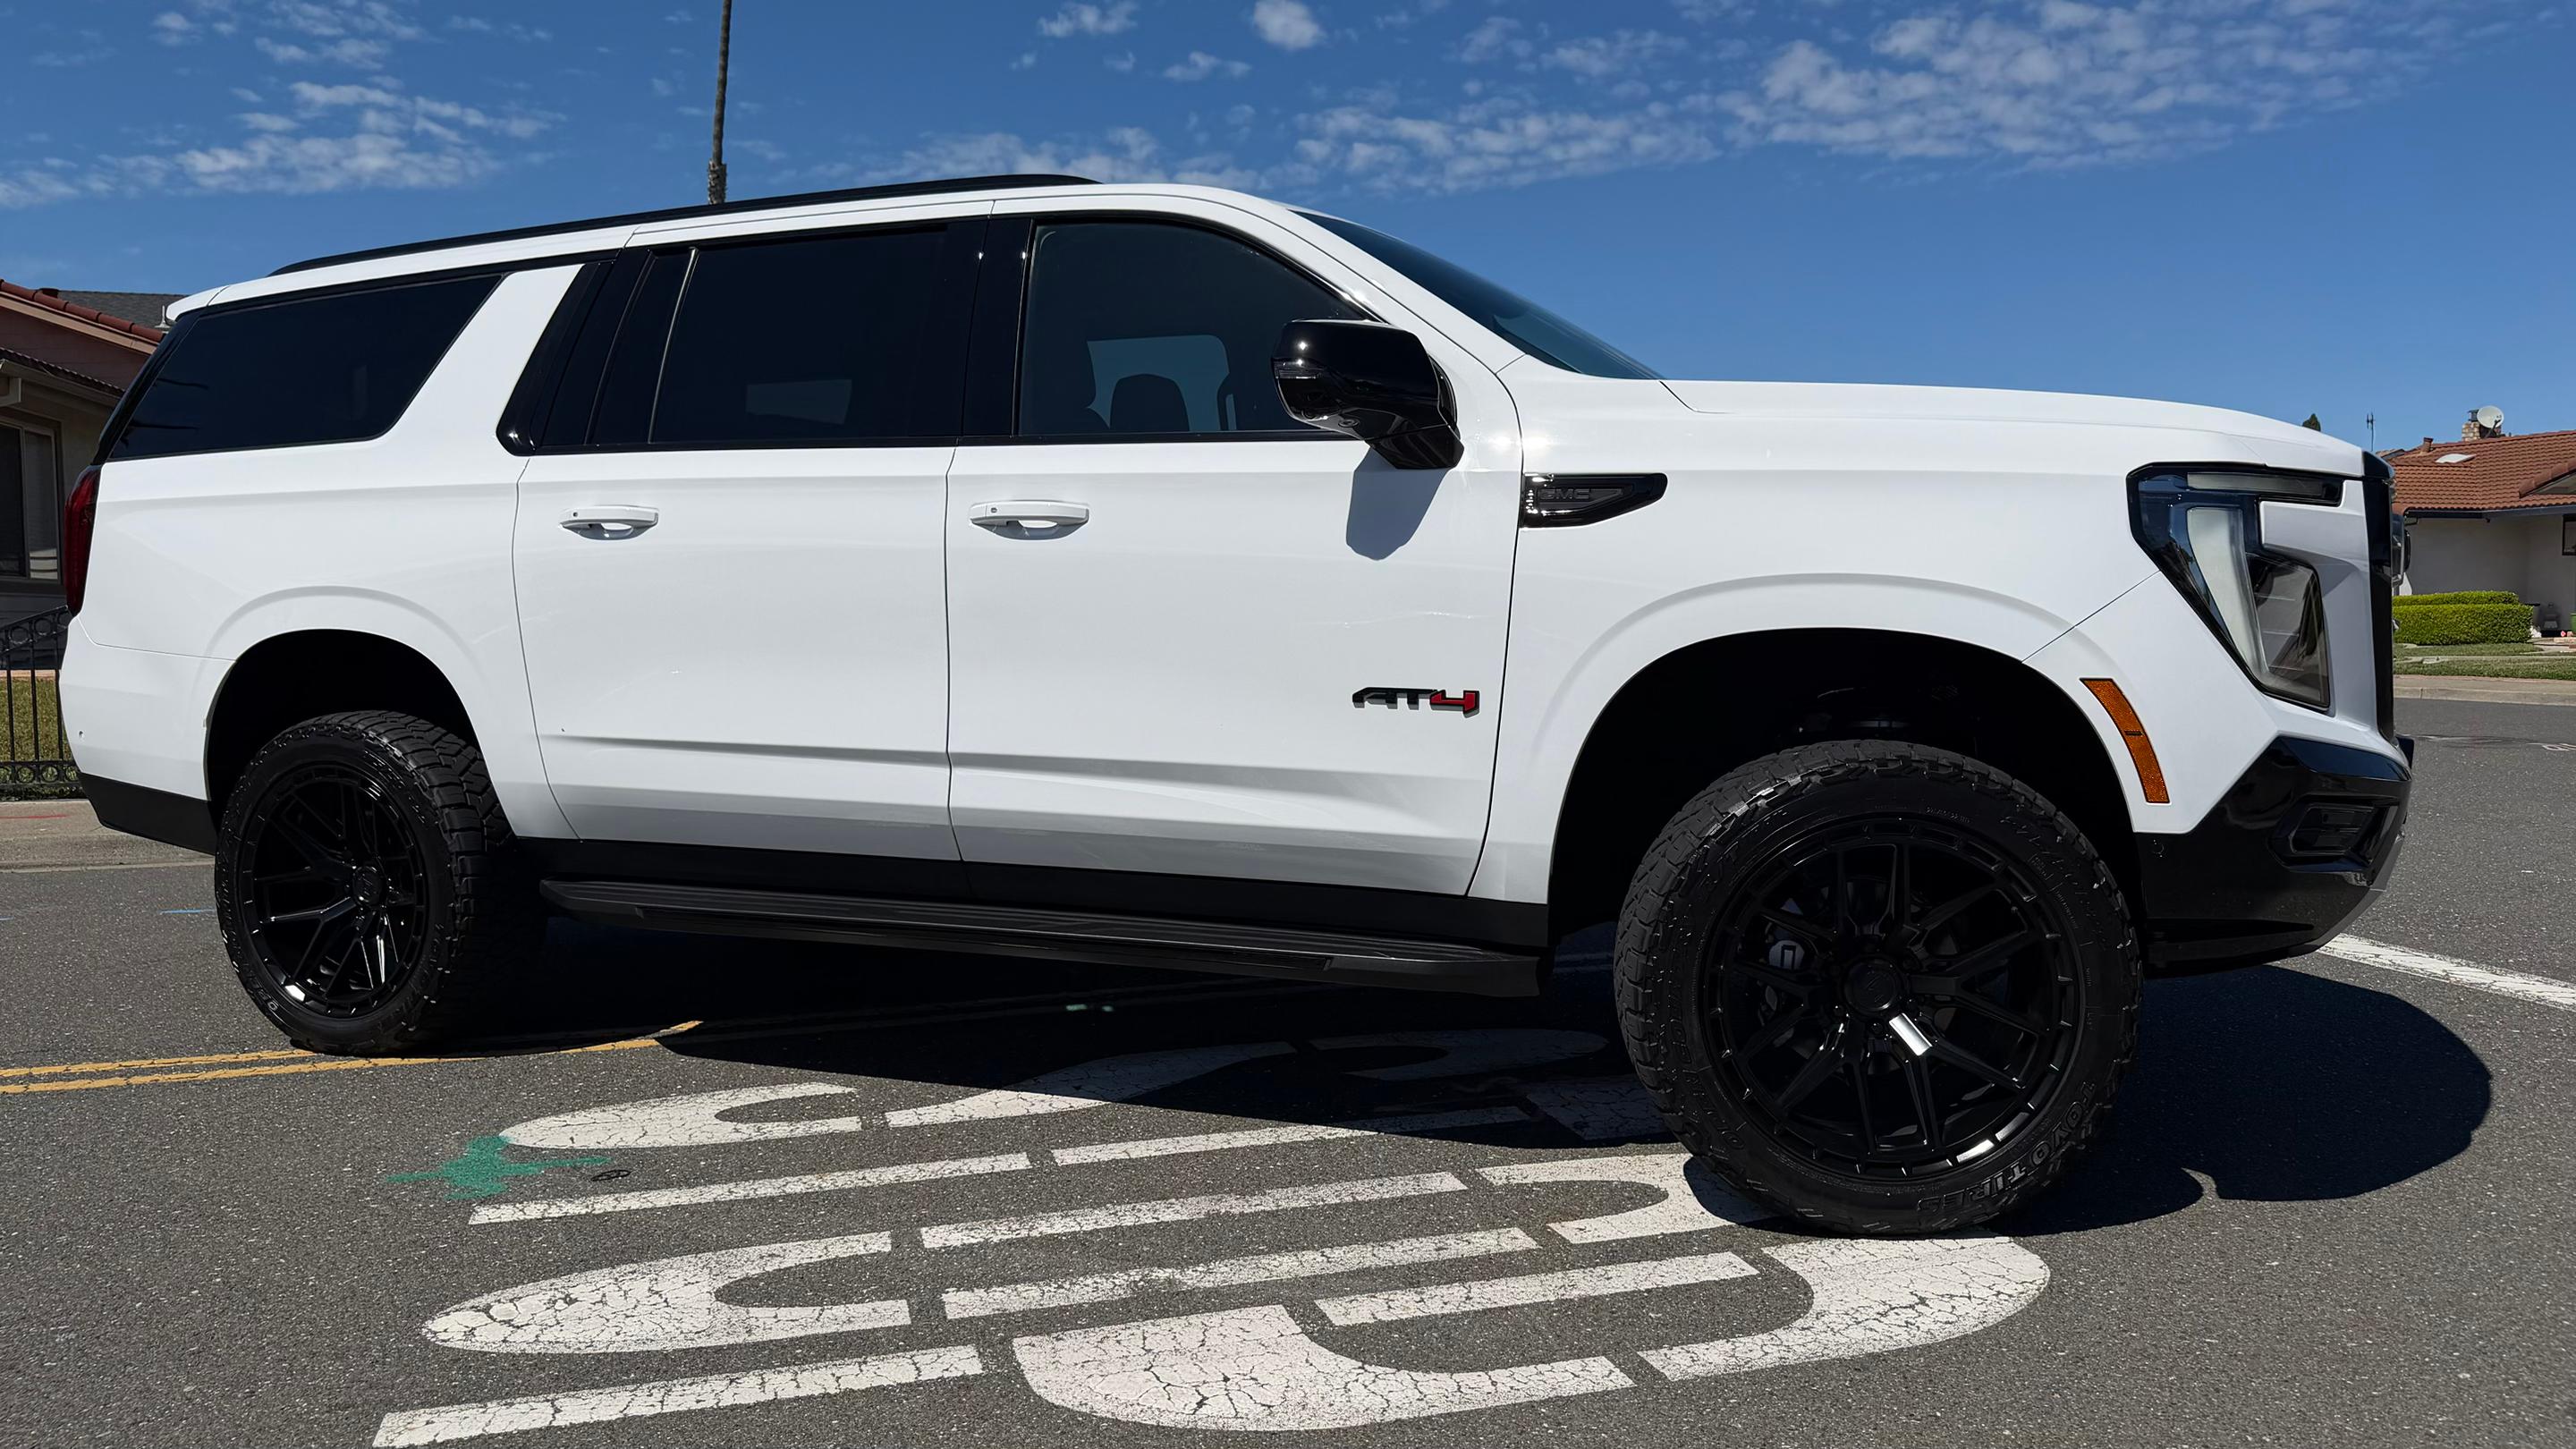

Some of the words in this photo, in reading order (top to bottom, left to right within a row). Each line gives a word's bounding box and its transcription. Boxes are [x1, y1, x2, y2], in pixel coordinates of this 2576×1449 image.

[1539, 488, 1590, 500] GMC
[1352, 687, 1480, 718] AT4
[2029, 1081, 2096, 1166] TOYO
[1917, 1162, 2027, 1212] TIRES
